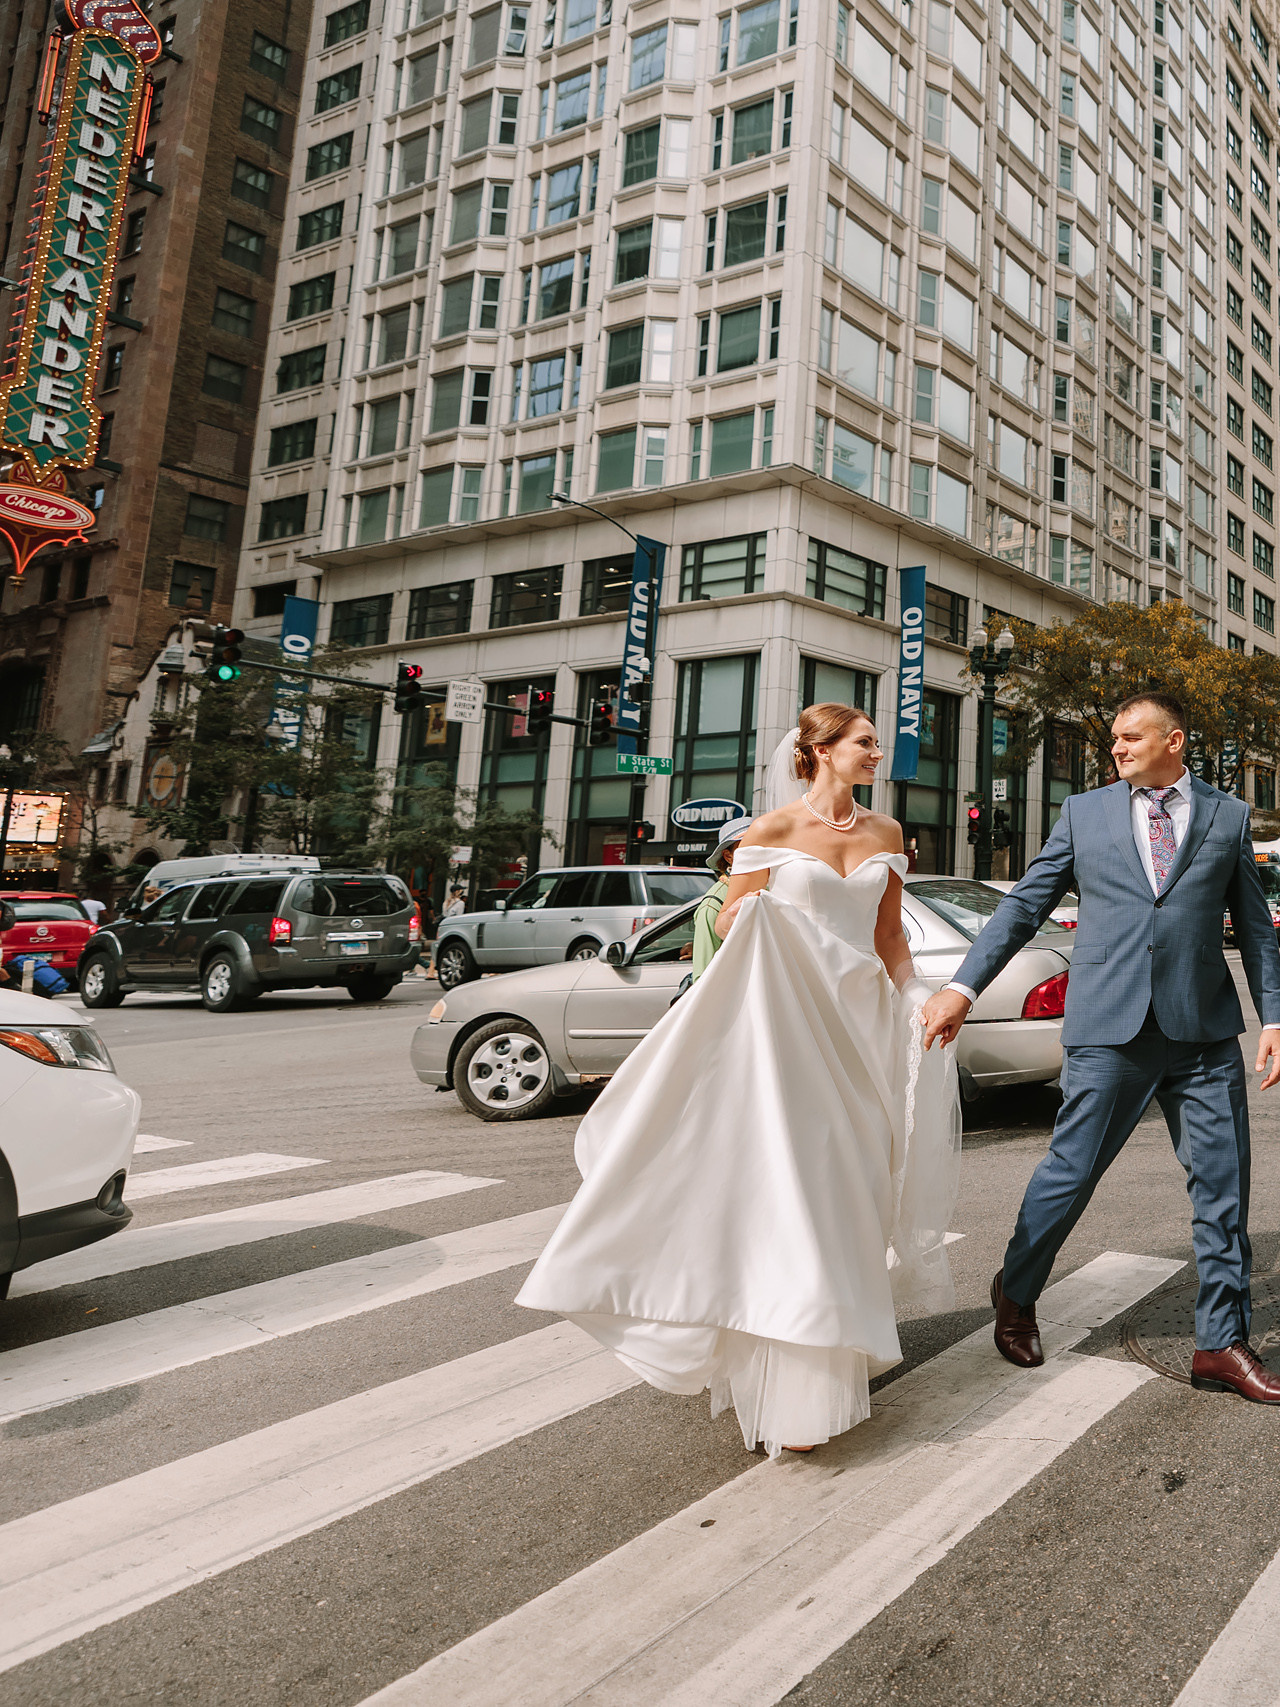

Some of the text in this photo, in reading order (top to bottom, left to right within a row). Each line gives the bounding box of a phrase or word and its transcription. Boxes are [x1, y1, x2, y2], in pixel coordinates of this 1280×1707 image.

[28, 51, 129, 450] NEDERLANDER
[5, 494, 66, 519] Chicago
[899, 607, 923, 738] OLD NAVY
[455, 692, 477, 701] GREEN
[454, 701, 476, 710] ARROW
[454, 710, 473, 719] ONLY
[620, 755, 670, 768] N State St
[643, 767, 657, 775] E/W
[676, 806, 735, 822] OLD NAVY
[677, 843, 708, 852] OLD NAVY
